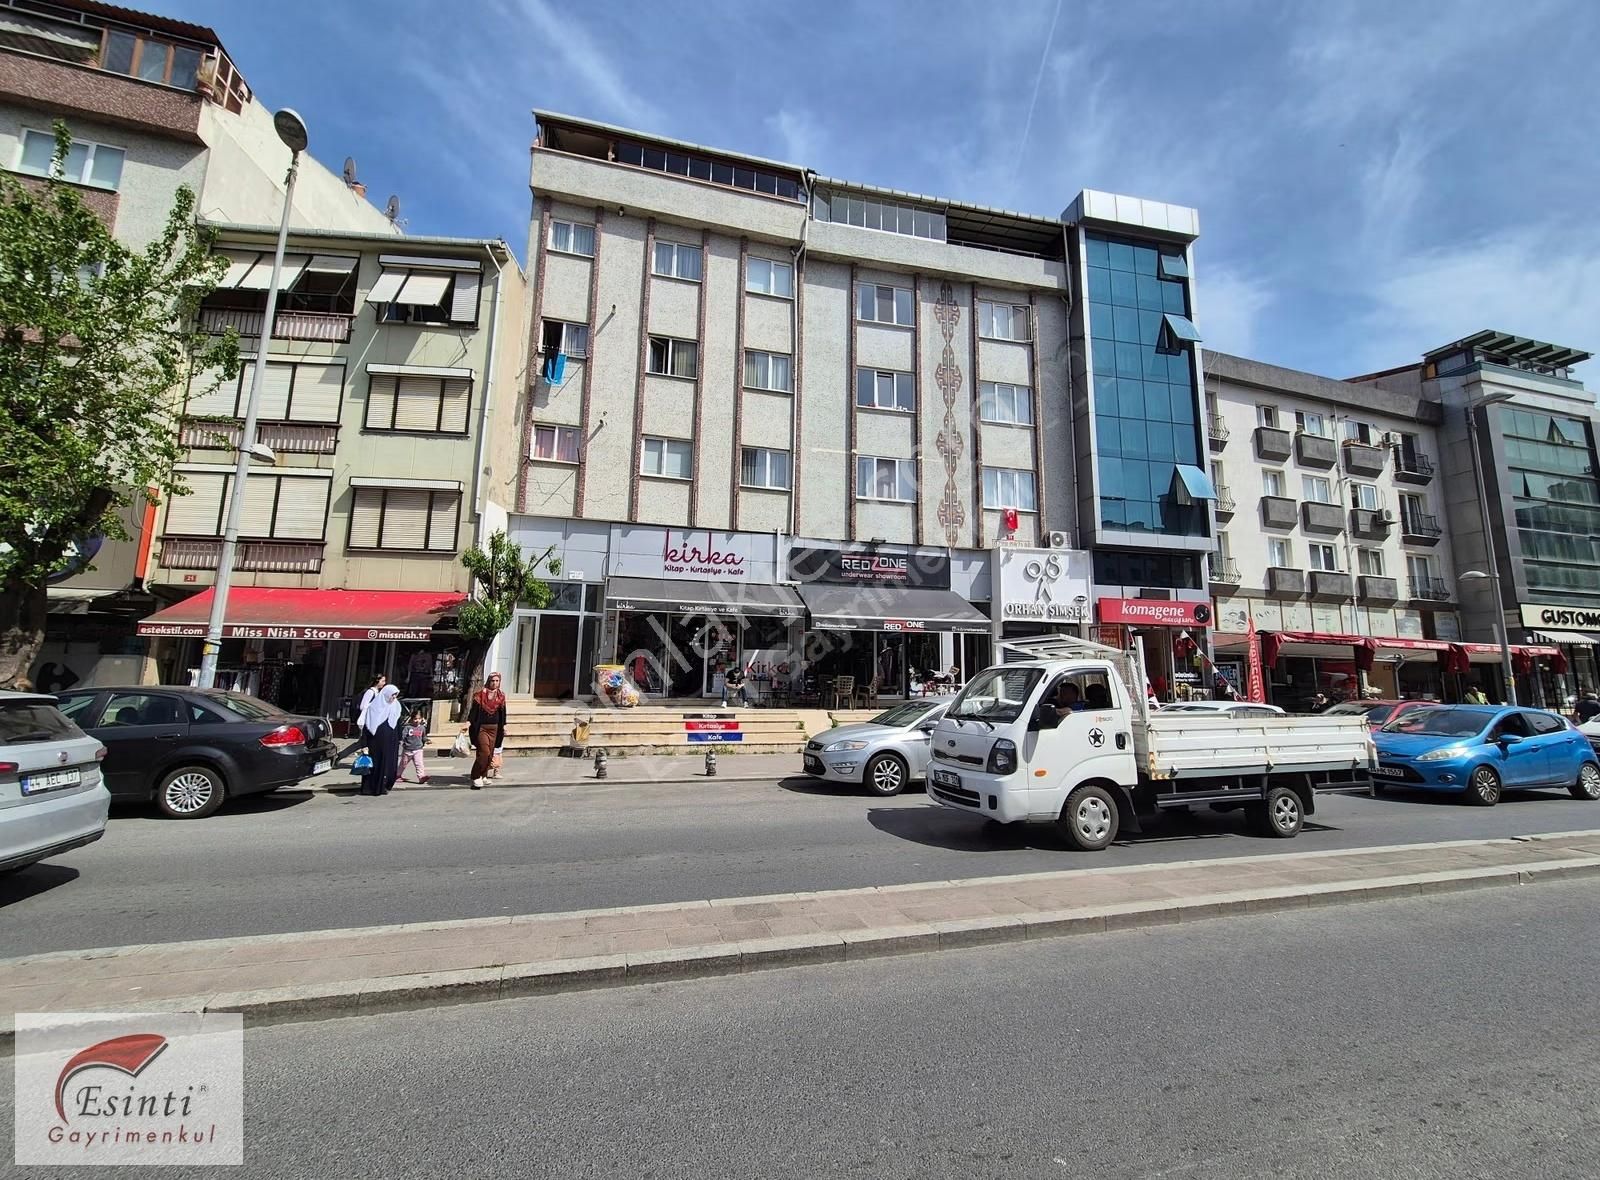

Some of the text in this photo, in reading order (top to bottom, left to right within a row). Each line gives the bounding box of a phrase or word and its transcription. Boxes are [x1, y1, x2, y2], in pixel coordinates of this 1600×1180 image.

[663, 528, 744, 566] kirka
[665, 565, 684, 574] Kitap
[1006, 603, 1046, 616] ORHAN
[1122, 601, 1185, 619] komagene
[140, 625, 203, 635] estekstil.com
[232, 627, 341, 638] Miss Nish Store
[379, 631, 427, 640] missnish.tr
